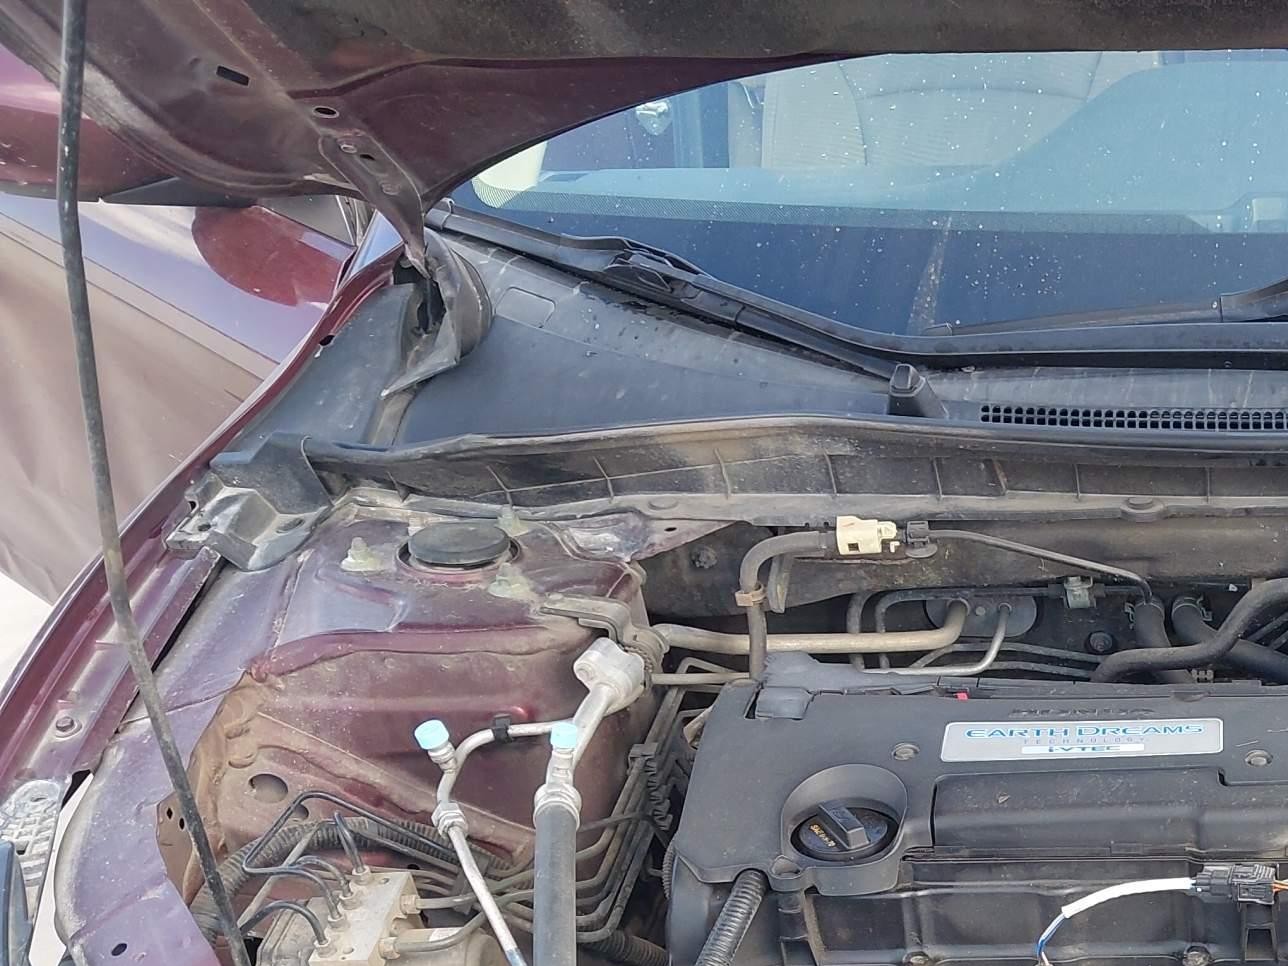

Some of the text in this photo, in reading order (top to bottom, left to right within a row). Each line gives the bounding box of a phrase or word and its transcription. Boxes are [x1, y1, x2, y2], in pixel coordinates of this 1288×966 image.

[965, 724, 1204, 739] EARTH DREAMS
[1047, 745, 1122, 753] i-VTEC
